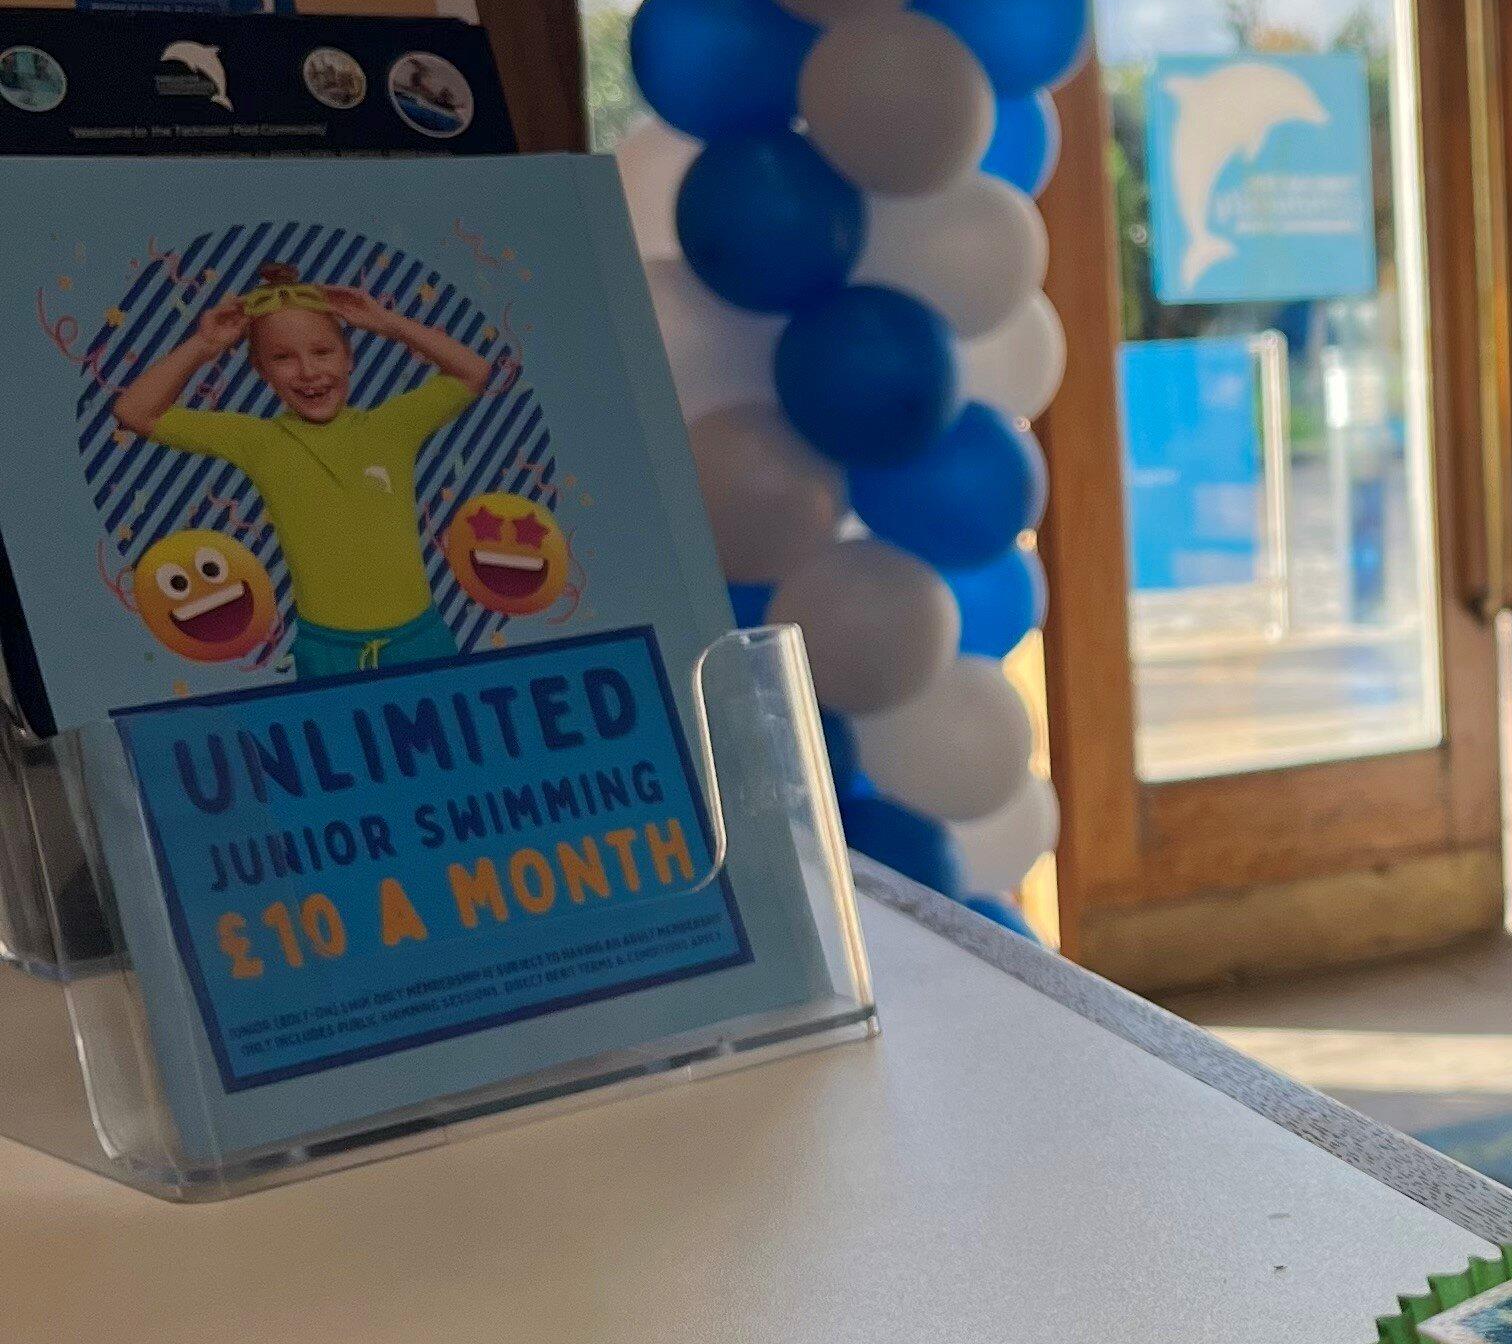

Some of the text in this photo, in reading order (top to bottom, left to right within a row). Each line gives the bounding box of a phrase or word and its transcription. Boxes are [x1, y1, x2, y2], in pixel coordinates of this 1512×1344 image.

[174, 668, 635, 814] UNLIMITED
[211, 761, 663, 891] JUNIOR SWIMMING
[217, 820, 693, 978] £10 A MONTH
